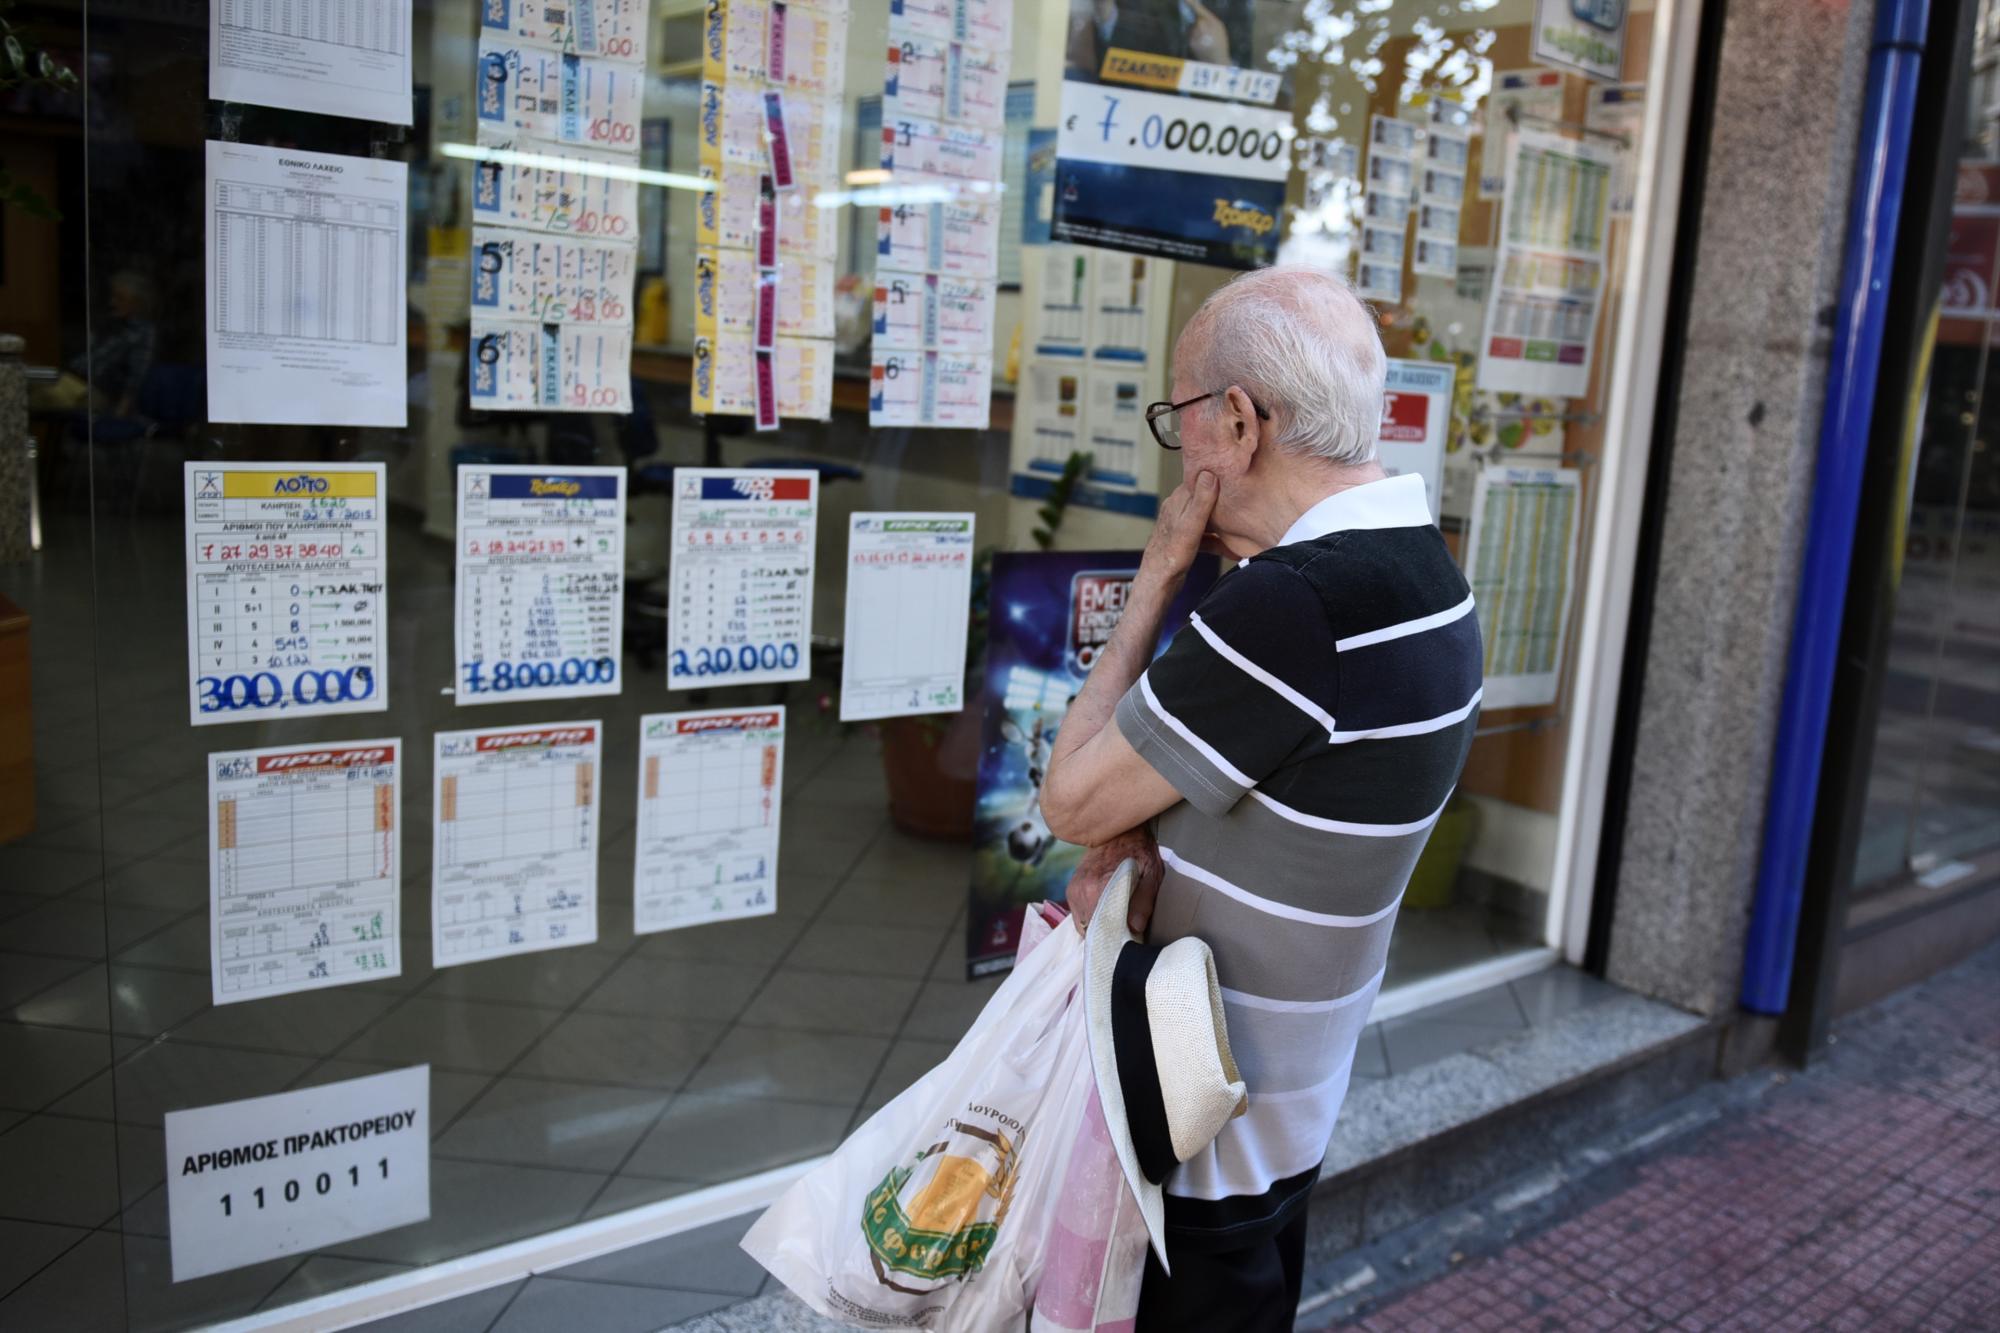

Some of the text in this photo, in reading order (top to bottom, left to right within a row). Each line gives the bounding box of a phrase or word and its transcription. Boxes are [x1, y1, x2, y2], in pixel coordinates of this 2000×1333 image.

[1096, 95, 1283, 161] 7.000.000
[278, 158, 311, 170] ΕΘΝΙΚΟ
[312, 162, 344, 174] ΛΑΧΕΙΟ
[480, 242, 503, 274] 5
[476, 333, 500, 365] 6
[885, 357, 899, 380] 6
[274, 475, 329, 494] ΛΟΤΤΟ
[265, 522, 284, 531] ΠΟΥ
[249, 544, 269, 560] 29
[182, 1110, 416, 1176] ΑΡΙΘΜΟΣ ΠΡΑΚΤΟΡΕΙΟΥ
